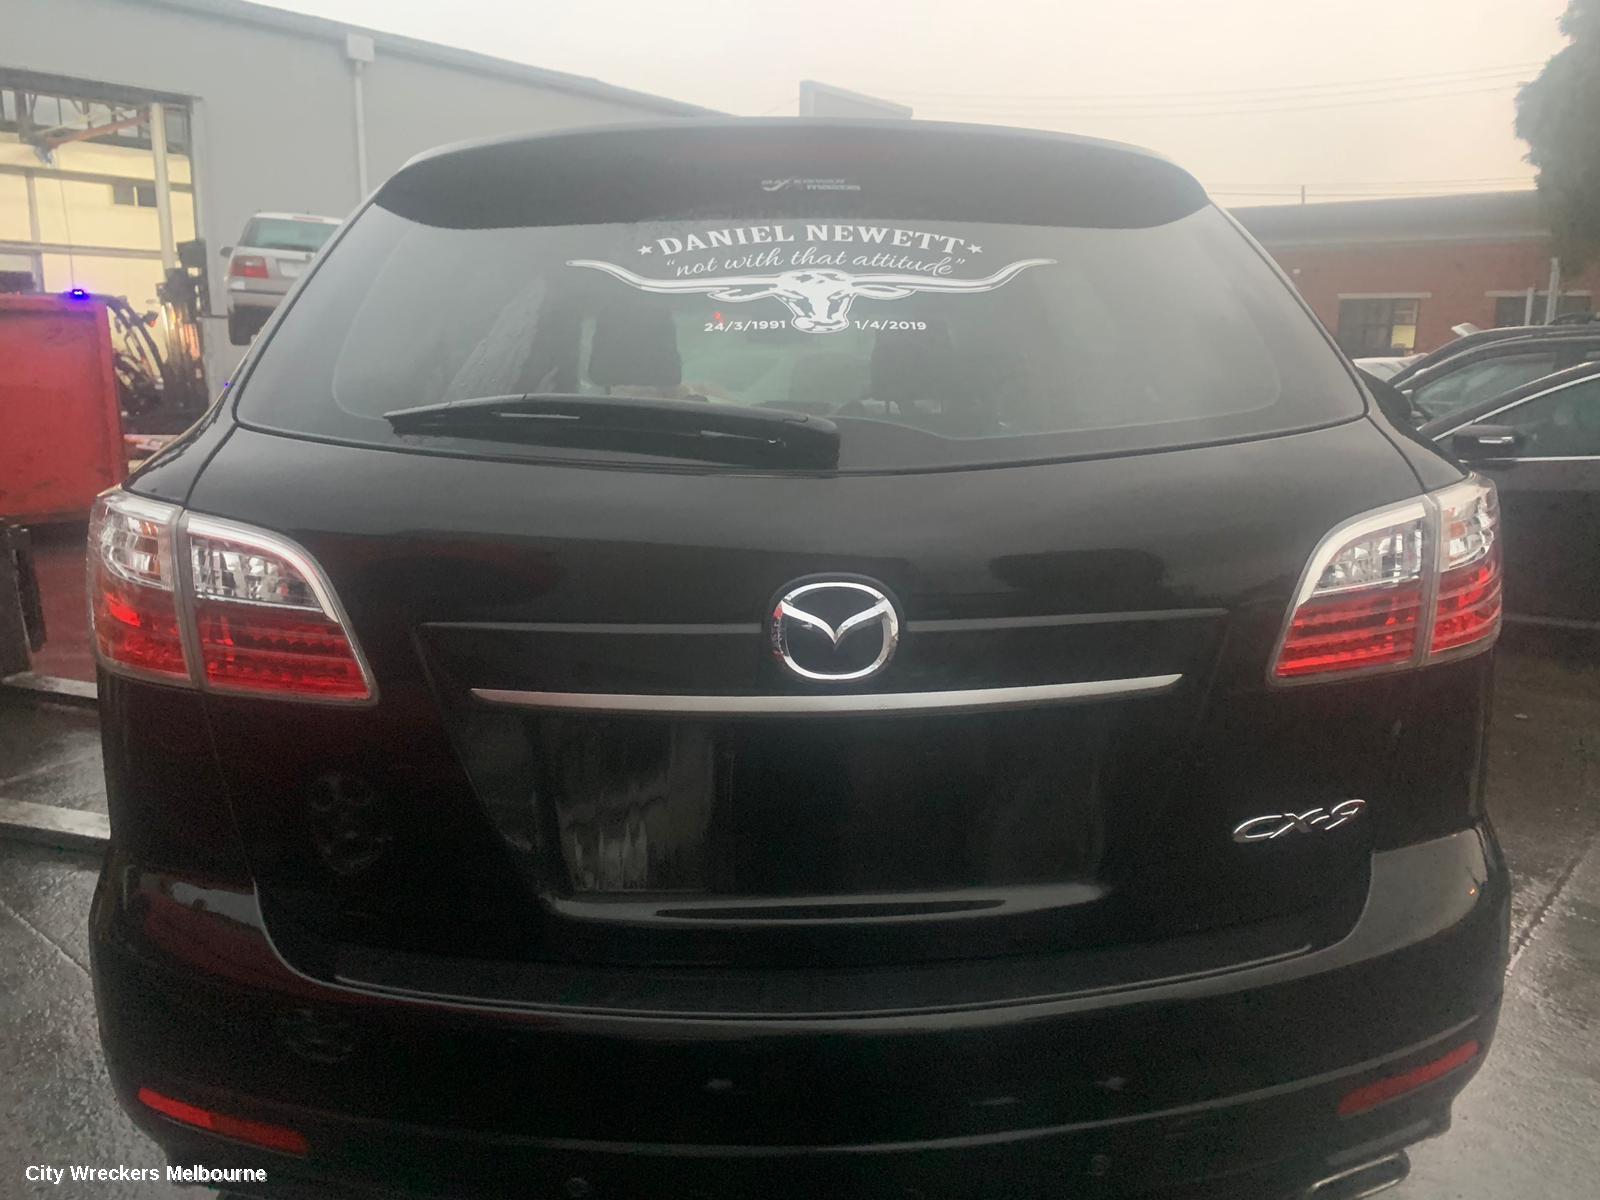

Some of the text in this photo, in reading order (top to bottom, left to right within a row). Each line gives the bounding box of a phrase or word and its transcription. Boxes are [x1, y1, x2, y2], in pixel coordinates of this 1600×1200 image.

[657, 224, 965, 255] DANIEL NEWETT
[723, 247, 785, 269] with
[789, 246, 847, 266] that
[704, 319, 927, 332] 24/3/1991 1/4/2019
